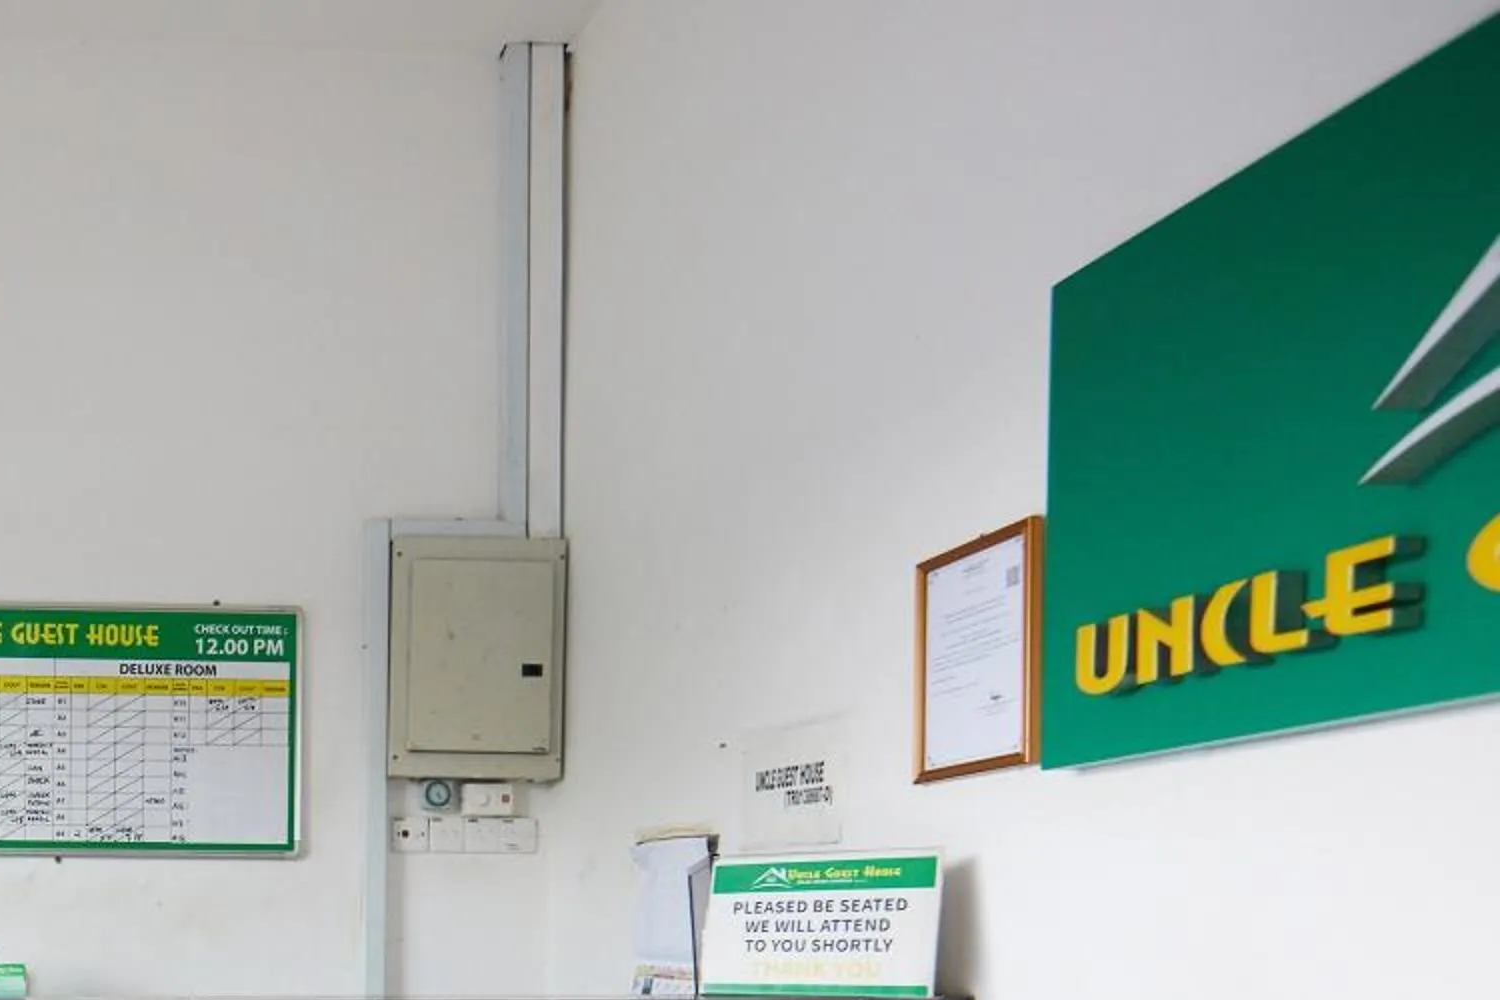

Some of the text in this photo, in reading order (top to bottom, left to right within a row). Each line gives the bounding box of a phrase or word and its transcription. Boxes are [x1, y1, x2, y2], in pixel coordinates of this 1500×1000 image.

[1075, 534, 1397, 695] UNCLE
[11, 622, 80, 645] GUEST
[86, 623, 159, 647] HOUSE
[195, 624, 229, 635] CHECK
[231, 625, 253, 636] OUT
[253, 625, 282, 636] TIME
[195, 638, 284, 656] 12.00 PM
[119, 663, 217, 676] DELUXE ROOM
[733, 898, 908, 915] PLEASED BE SEATED
[745, 918, 891, 933] WE WILL ATTEND
[744, 938, 893, 953] TO YOU SHORTLY
